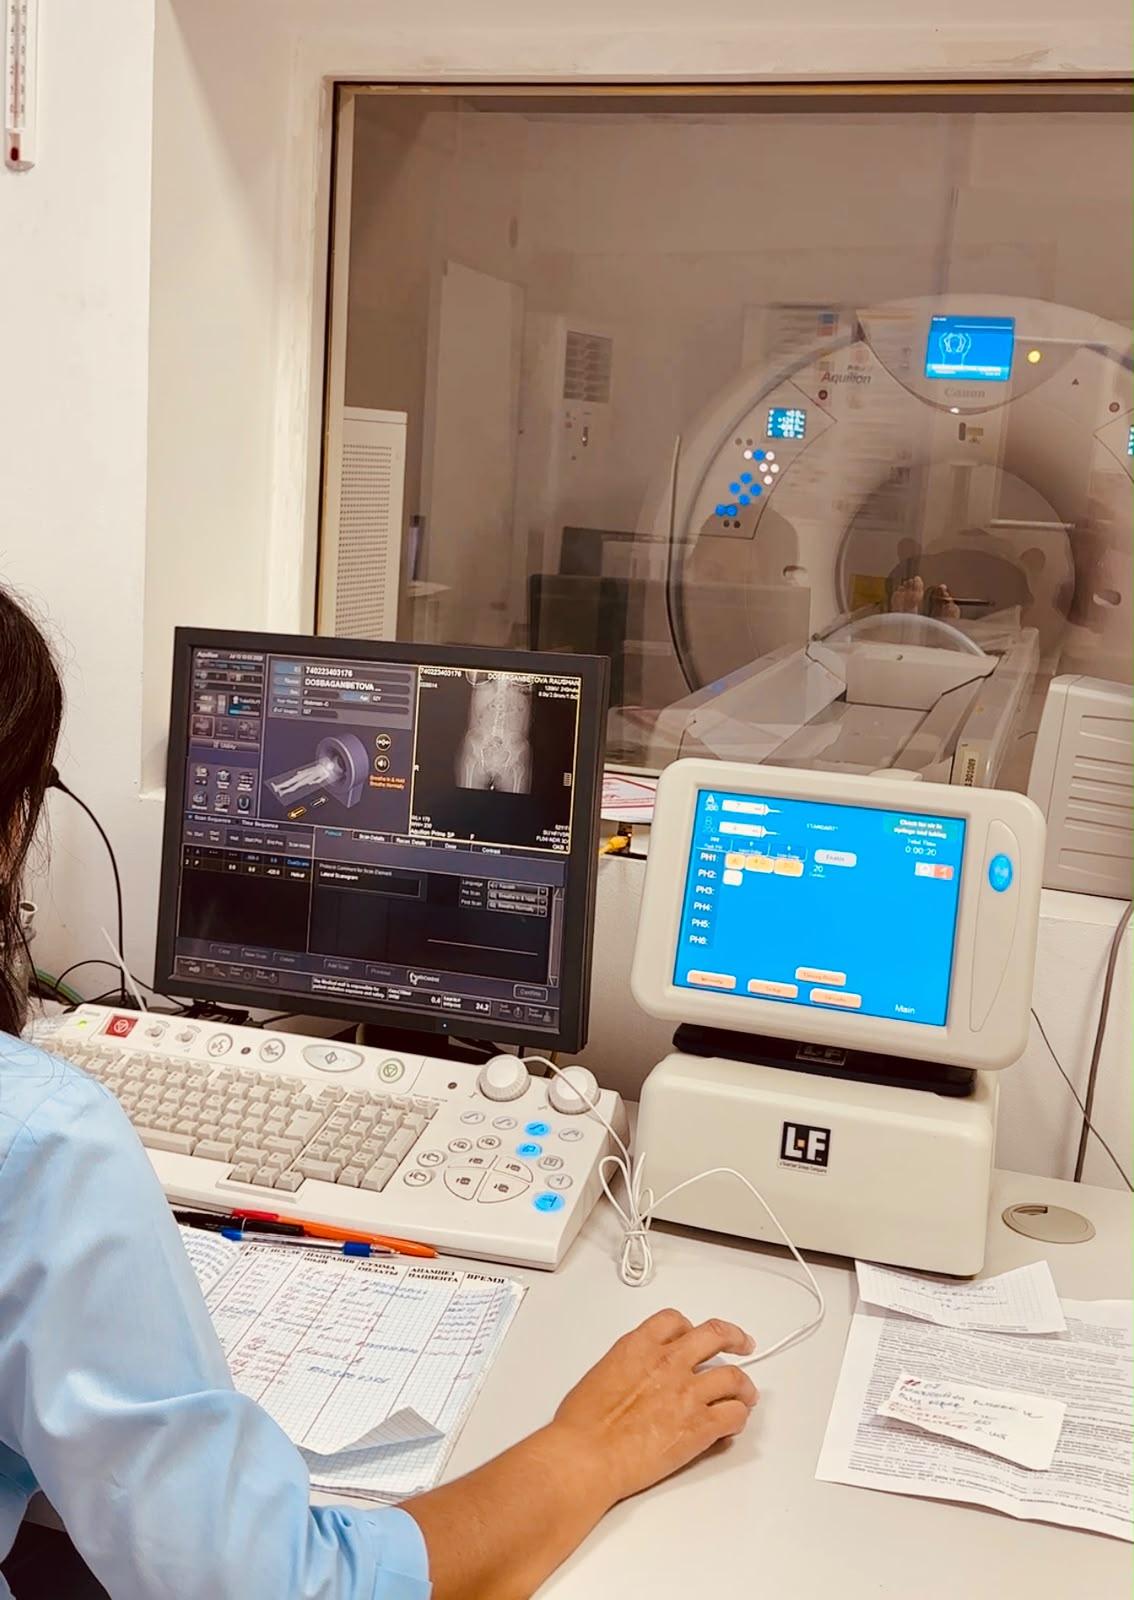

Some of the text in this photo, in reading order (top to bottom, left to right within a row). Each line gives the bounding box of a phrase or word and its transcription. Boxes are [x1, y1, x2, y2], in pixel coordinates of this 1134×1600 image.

[944, 387, 986, 399] Canon
[207, 816, 231, 824] Sequence
[254, 821, 279, 829] Sequence
[700, 852, 719, 862] PH1:
[698, 869, 717, 879] PH2:
[695, 885, 715, 895] PH3:
[693, 901, 713, 912] PH4:
[691, 918, 711, 928] PH5:
[689, 935, 709, 945] PH6:
[894, 1004, 916, 1015] Main
[360, 1261, 396, 1271] СУММА
[357, 1267, 399, 1277] ОПЛАТЫ
[466, 1273, 506, 1285] ВРЕМЯ
